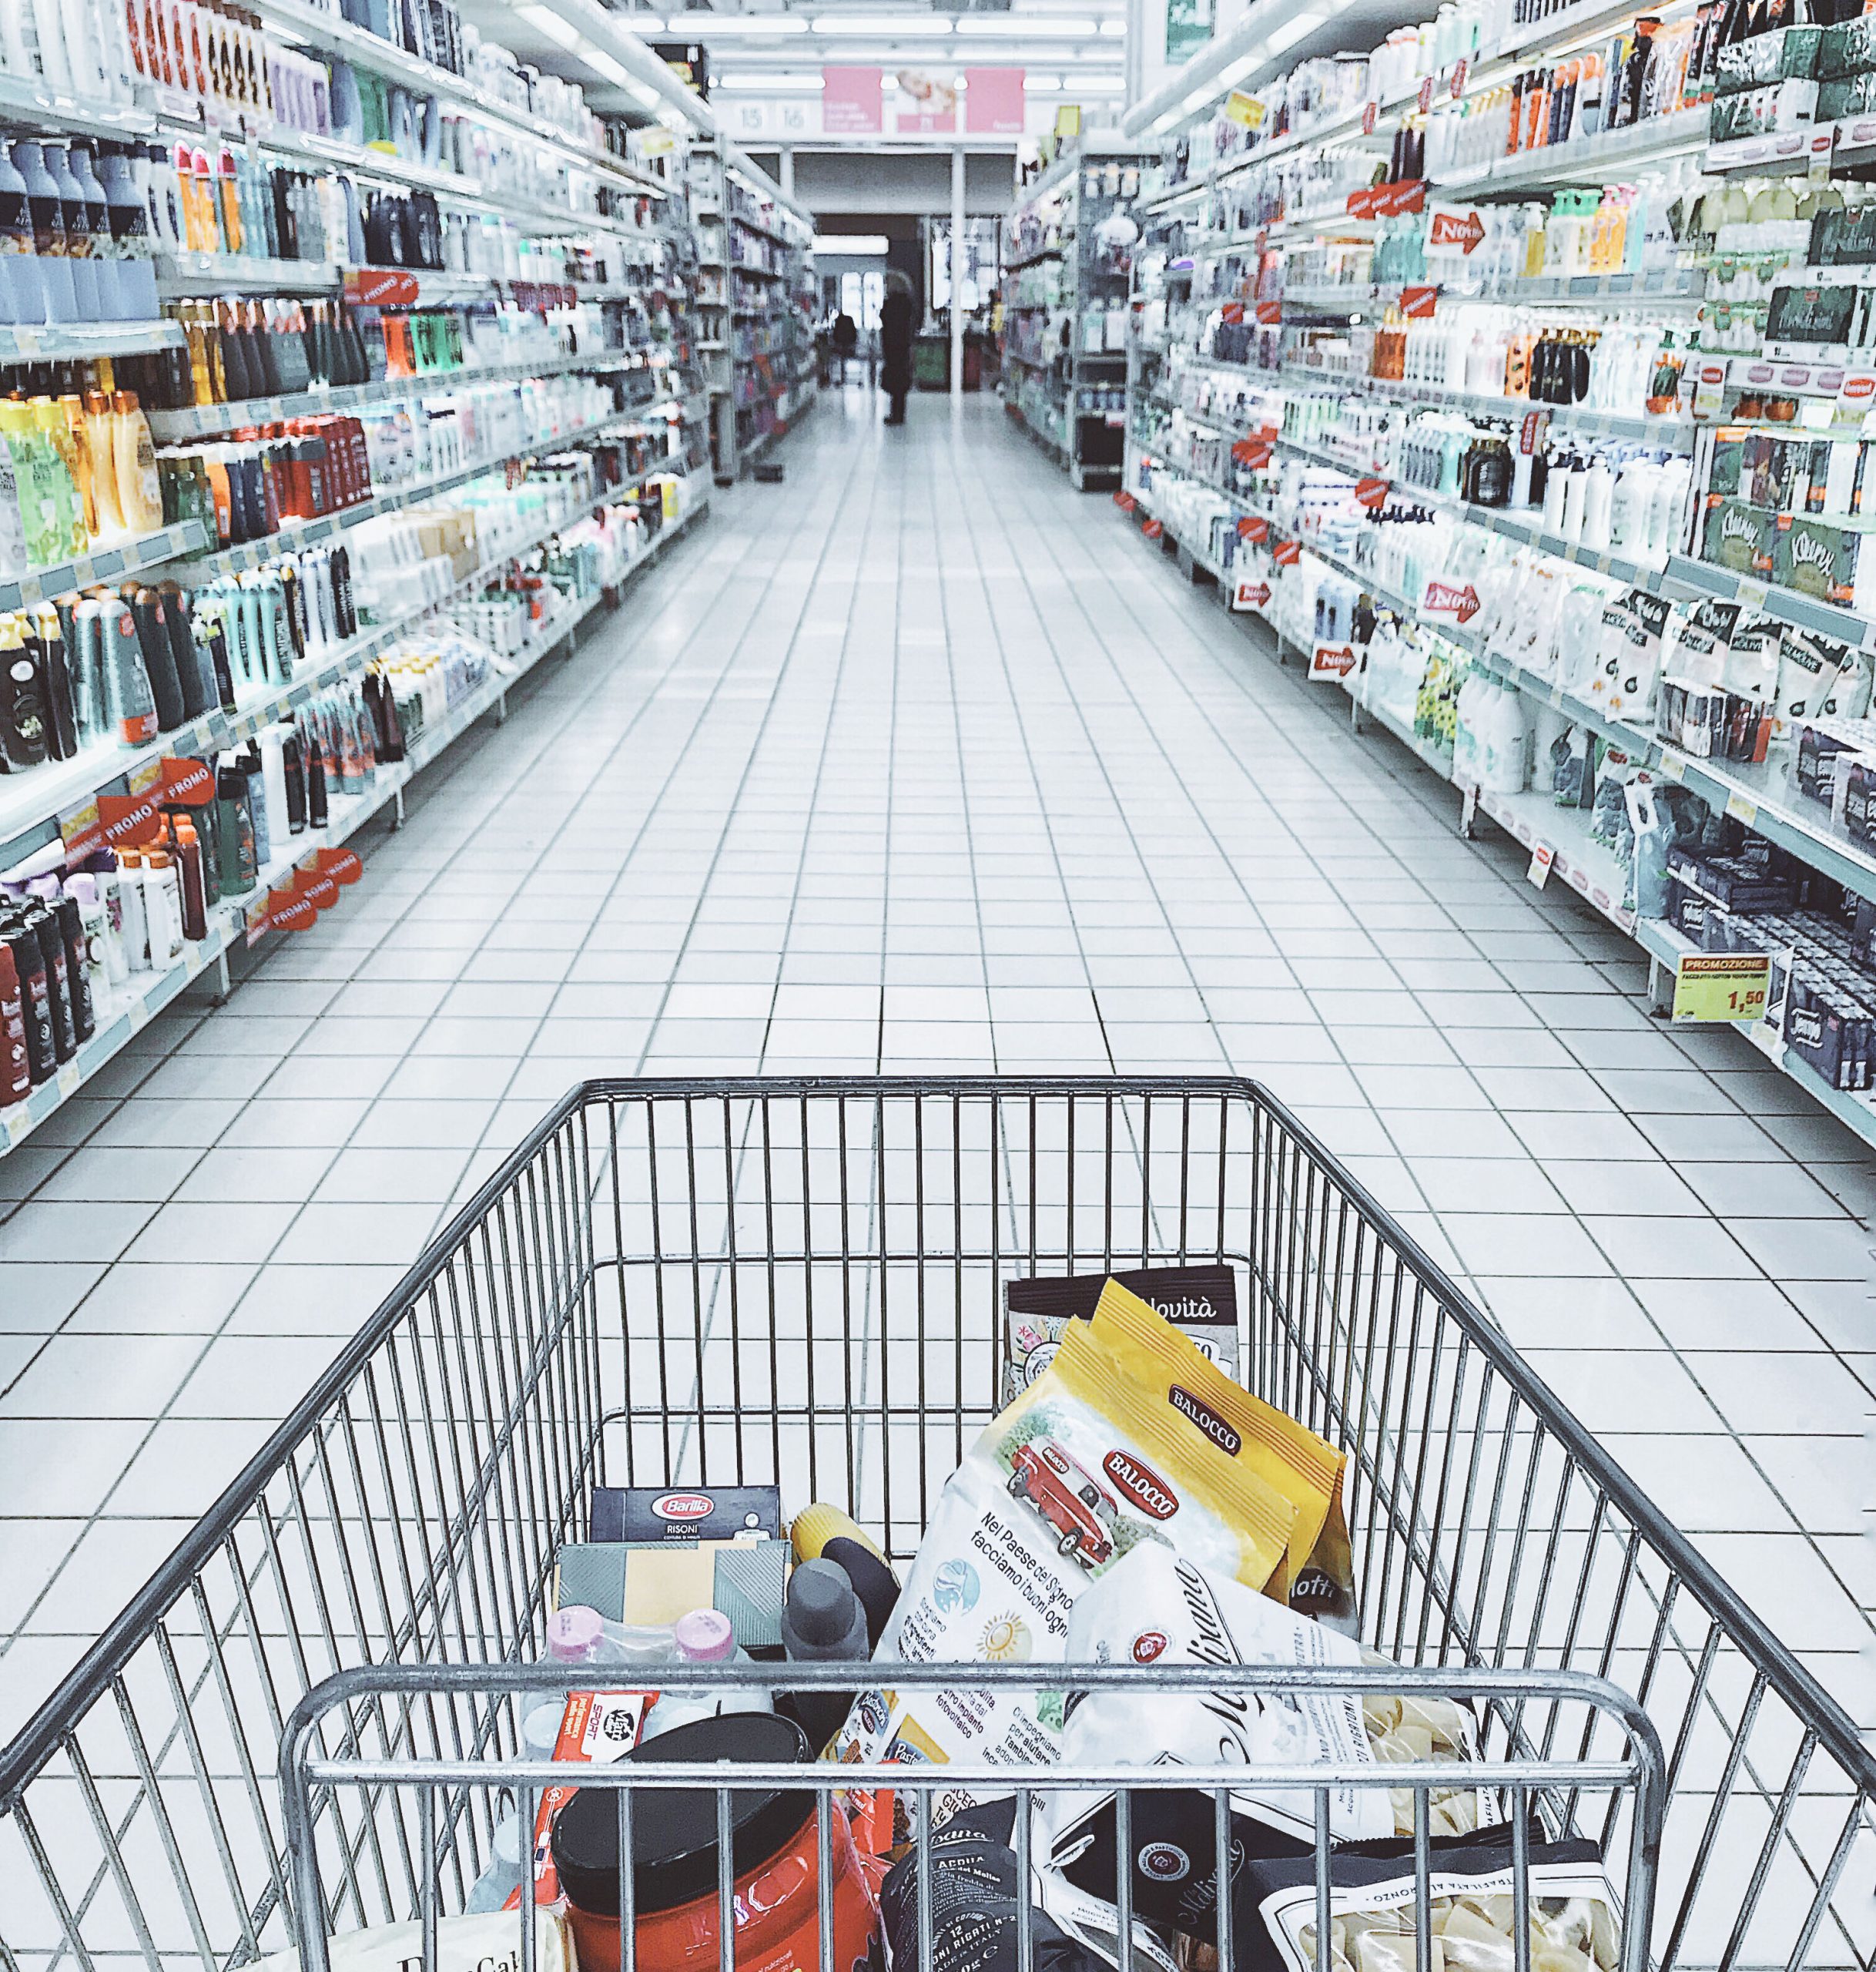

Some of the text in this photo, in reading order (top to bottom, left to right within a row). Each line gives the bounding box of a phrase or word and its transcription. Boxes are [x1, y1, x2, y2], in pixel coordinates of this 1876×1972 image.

[168, 767, 209, 798] PROMO
[105, 804, 152, 840] PROMO
[325, 854, 357, 875] ROMO
[303, 878, 333, 899] ROMO
[272, 900, 311, 925] PROMO
[1685, 959, 1764, 970] PROMOZIONE
[1727, 990, 1765, 1013] 1,50
[1171, 1390, 1238, 1450] BALOCCO
[1044, 1447, 1069, 1474] BALOCCO
[1107, 1454, 1177, 1515] BALOCCO
[666, 1500, 709, 1512] Barilla
[667, 1524, 698, 1534] RISONI
[970, 1530, 1023, 1586] facciamo
[980, 1511, 1074, 1611] Nel Paese del Signo
[1019, 1578, 1030, 1591] i
[1023, 1583, 1051, 1615] buoni
[974, 1690, 996, 1711] ulita,
[975, 1702, 988, 1717] dal
[571, 1697, 588, 1739] performance
[587, 1703, 603, 1740] SPORT
[936, 1695, 972, 1739] fotovoltaico
[956, 1699, 984, 1733] impianto
[1343, 1700, 1365, 1749] RIGATONI
[1009, 1723, 1051, 1766] per aiutare
[1019, 1712, 1061, 1761] impegniamo
[1373, 1877, 1514, 1902] TRAFILATA AL RONZO
[950, 1925, 963, 1938] 12
[953, 1922, 991, 1950] RIGATI
[970, 1928, 1001, 1950] ITALY
